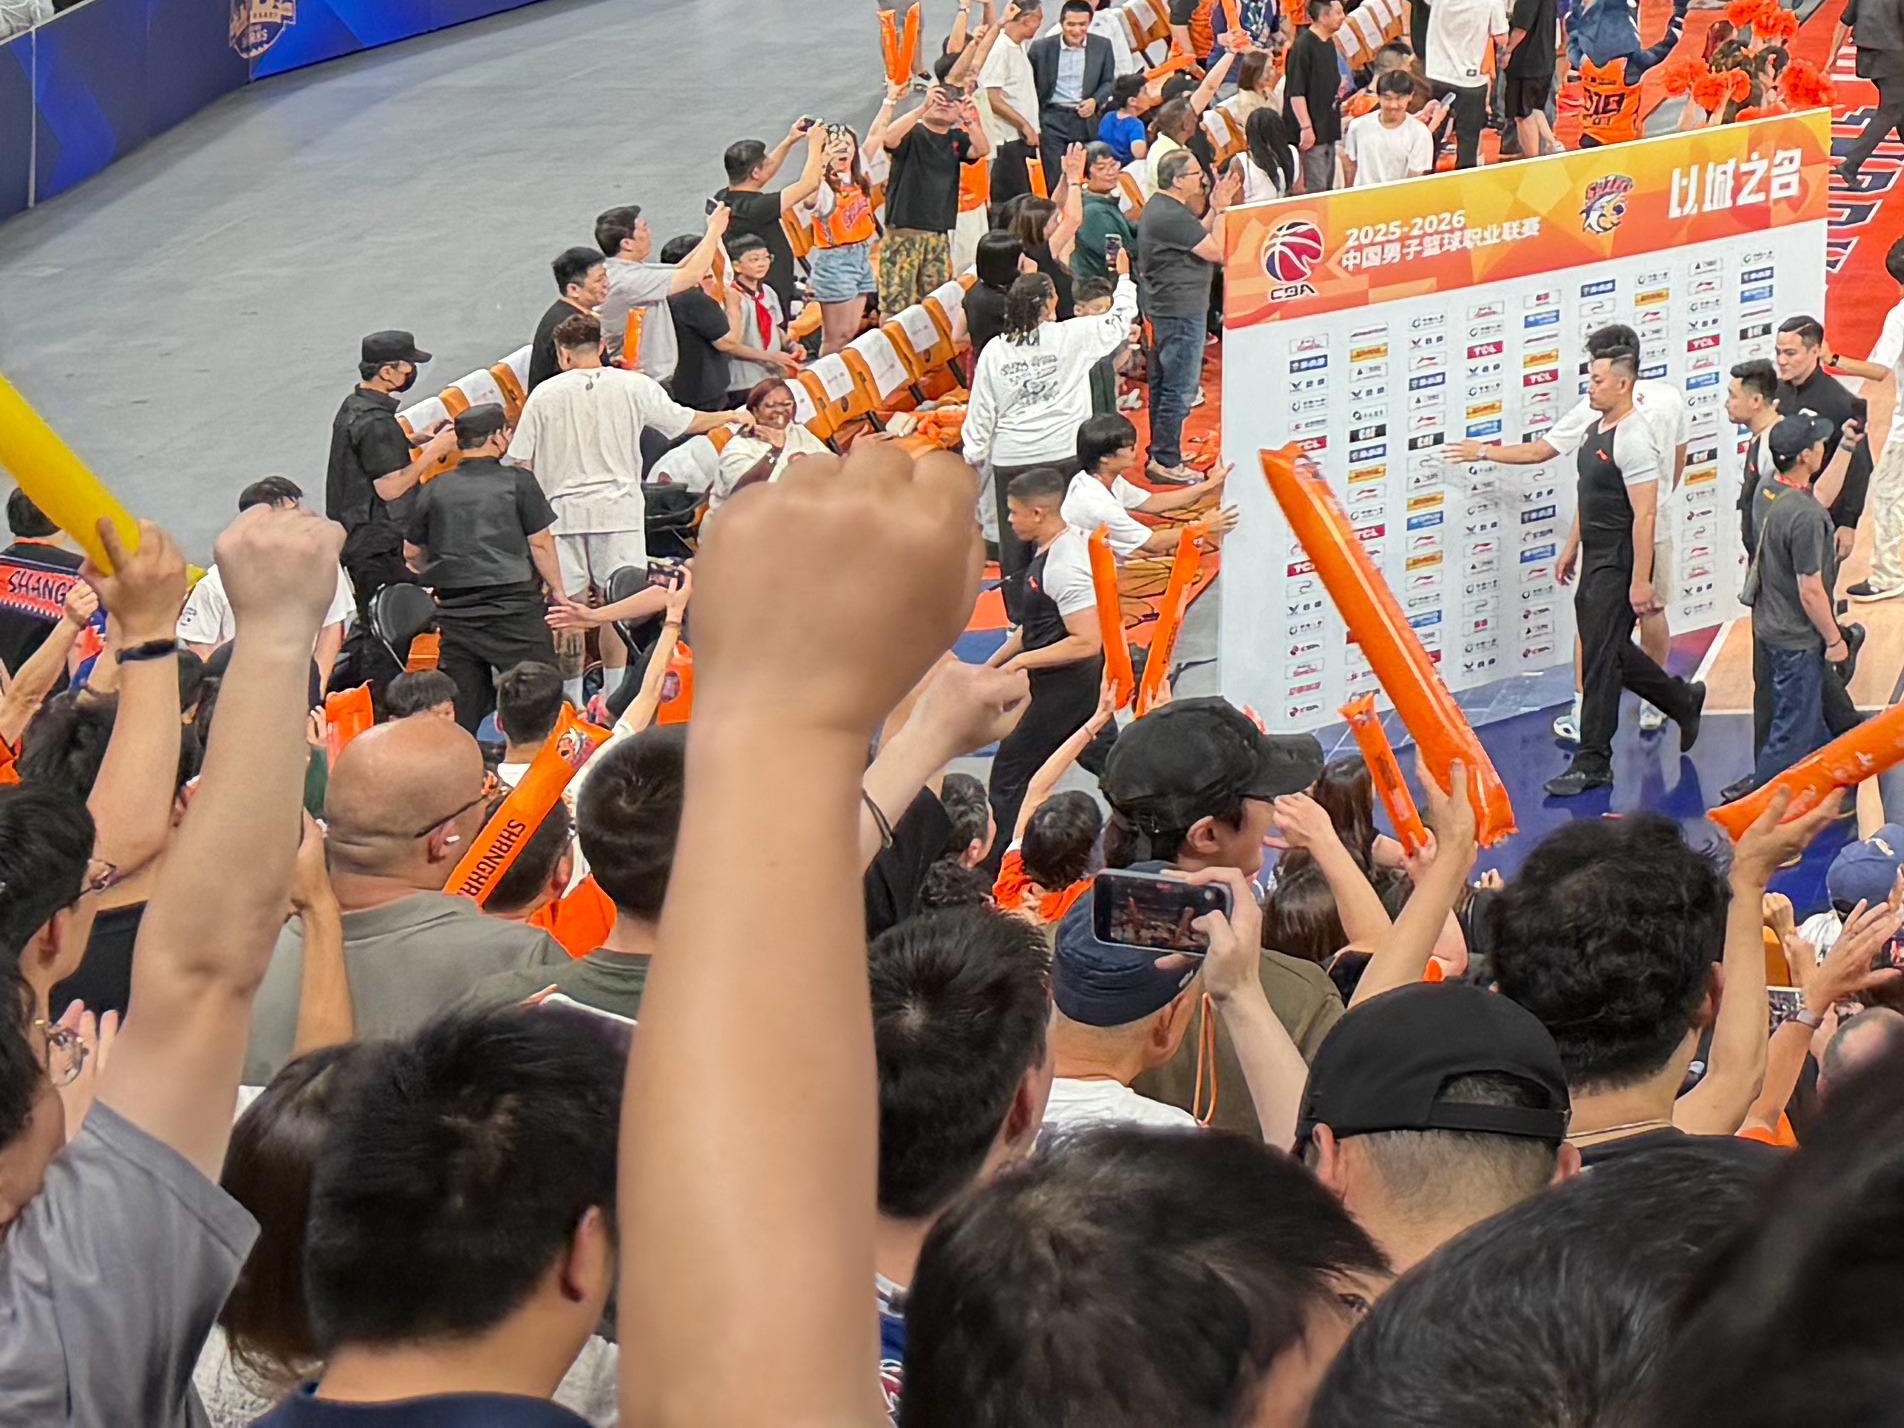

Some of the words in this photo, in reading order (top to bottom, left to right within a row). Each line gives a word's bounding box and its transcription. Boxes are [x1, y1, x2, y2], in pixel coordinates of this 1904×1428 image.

[1668, 147, 1803, 220] 以城之名
[1341, 217, 1542, 272] 中国男子篮球职业联赛
[1346, 210, 1467, 243] 2025-2026
[1270, 283, 1317, 301] CBA
[8, 569, 74, 607] SHANG
[456, 818, 527, 897] SHANGHA
